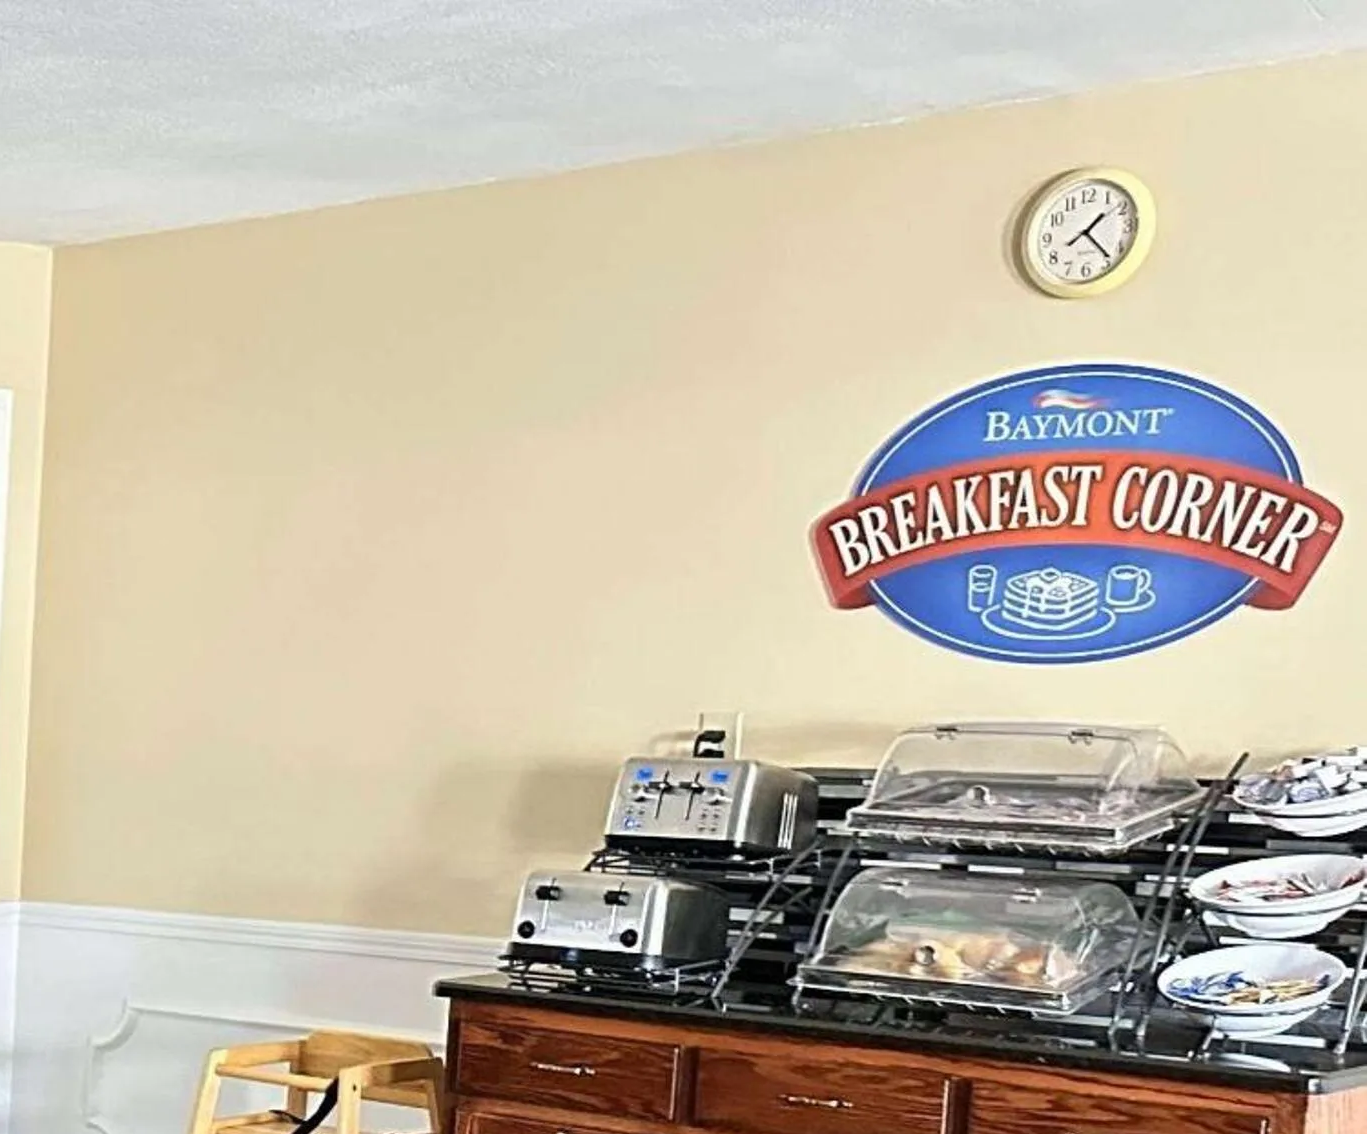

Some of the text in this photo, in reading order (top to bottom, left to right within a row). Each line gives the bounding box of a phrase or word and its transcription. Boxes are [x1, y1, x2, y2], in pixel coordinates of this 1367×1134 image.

[1081, 188, 1096, 204] 12
[1105, 191, 1111, 204] 1
[1065, 196, 1076, 212] 11
[1117, 201, 1127, 216] 2
[1051, 211, 1063, 227] 10
[1123, 219, 1133, 234] 3
[1042, 233, 1052, 248] 9
[1049, 250, 1058, 264] 8
[1064, 260, 1072, 276] 7
[1080, 262, 1091, 277] 6
[984, 408, 1168, 442] BAYMONT
[828, 464, 1320, 577] BREAKFAST CORNER
